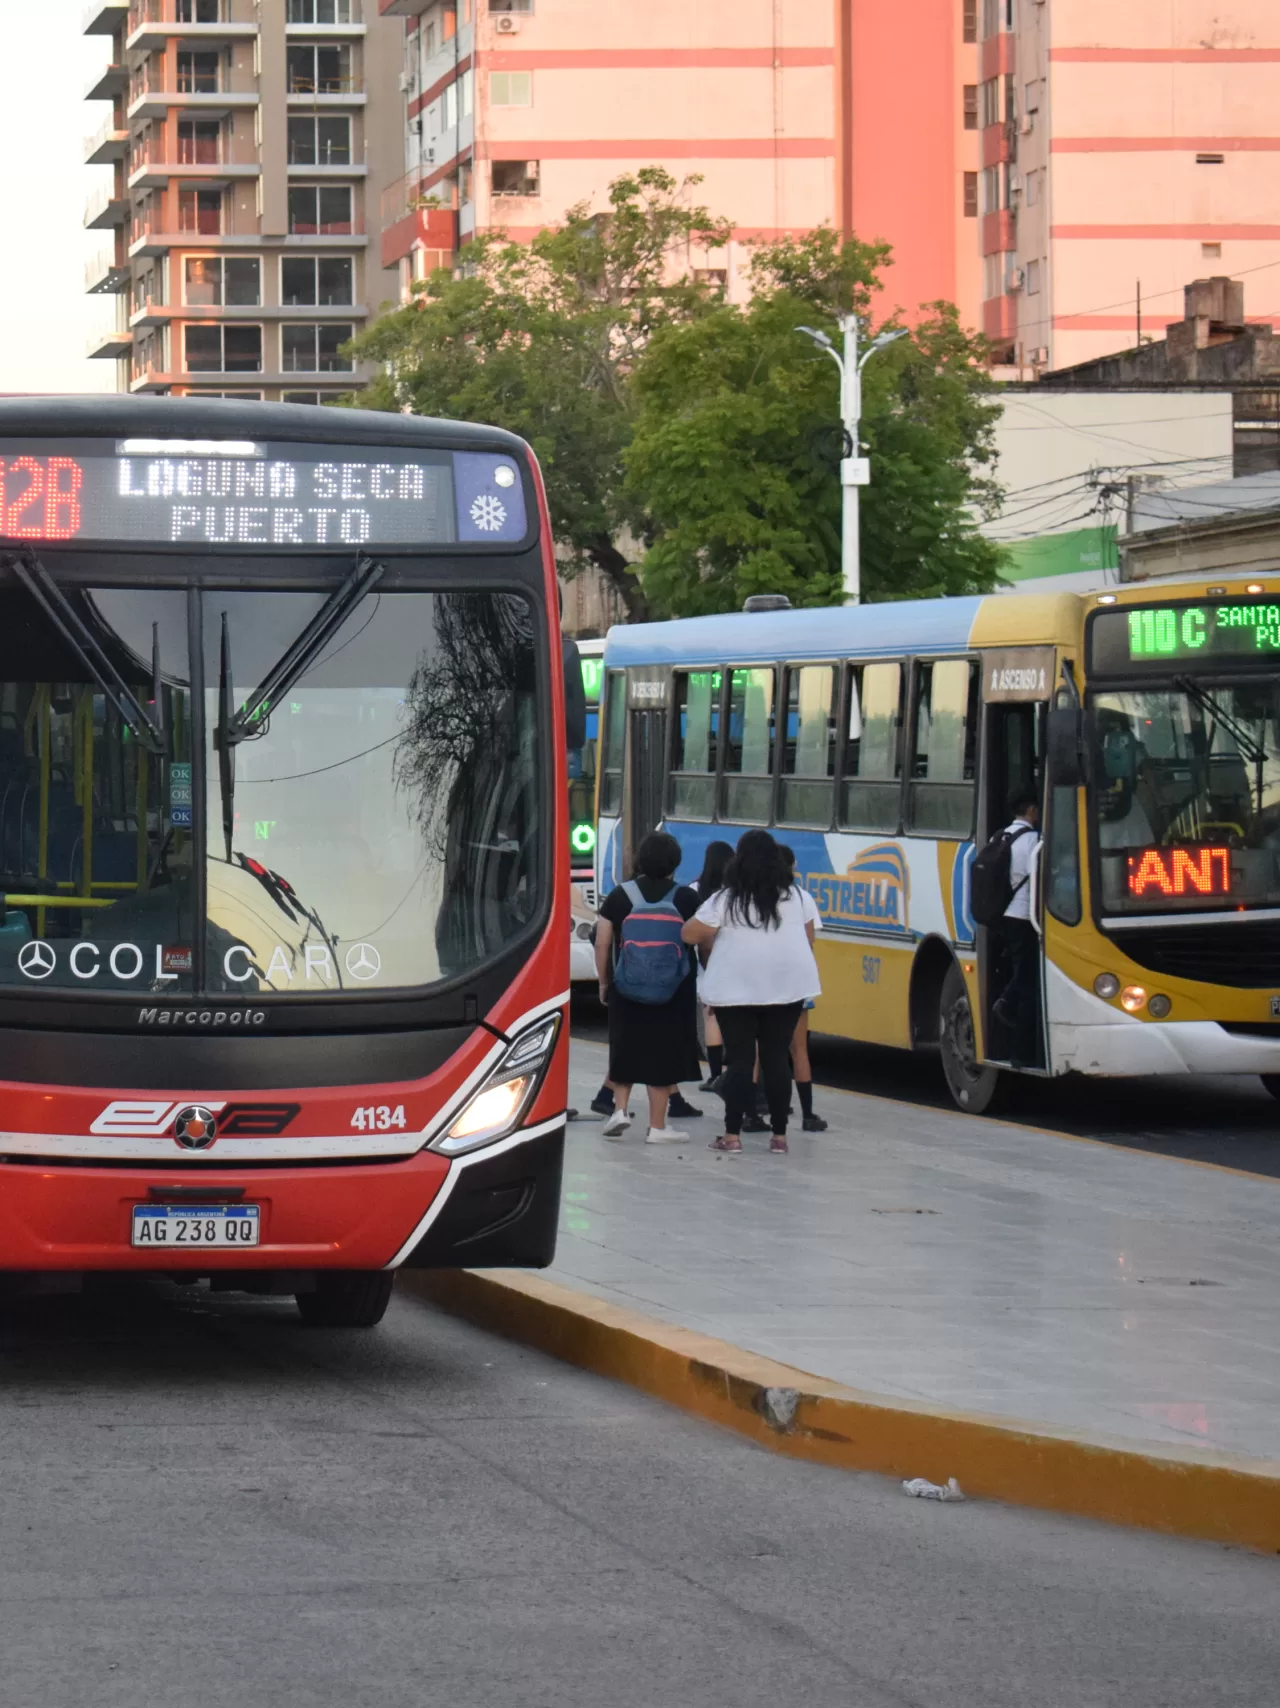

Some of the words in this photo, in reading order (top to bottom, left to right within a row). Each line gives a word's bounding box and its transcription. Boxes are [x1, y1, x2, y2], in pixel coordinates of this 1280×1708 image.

[119, 458, 296, 499] LAGUNA
[313, 462, 424, 500] SECA
[171, 505, 371, 544] PUERTO
[1216, 605, 1280, 627] SANTA
[1127, 609, 1177, 653] 110
[1181, 608, 1207, 648] C
[171, 769, 189, 779] OK
[171, 790, 190, 800] OK
[172, 811, 189, 821] OK
[69, 942, 179, 979] COL
[223, 945, 333, 982] CAR
[137, 1007, 266, 1025] Marcopolo
[350, 1104, 407, 1130] 4134
[139, 1220, 168, 1242] AG
[175, 1220, 217, 1242] 238
[225, 1220, 253, 1242] QQ
